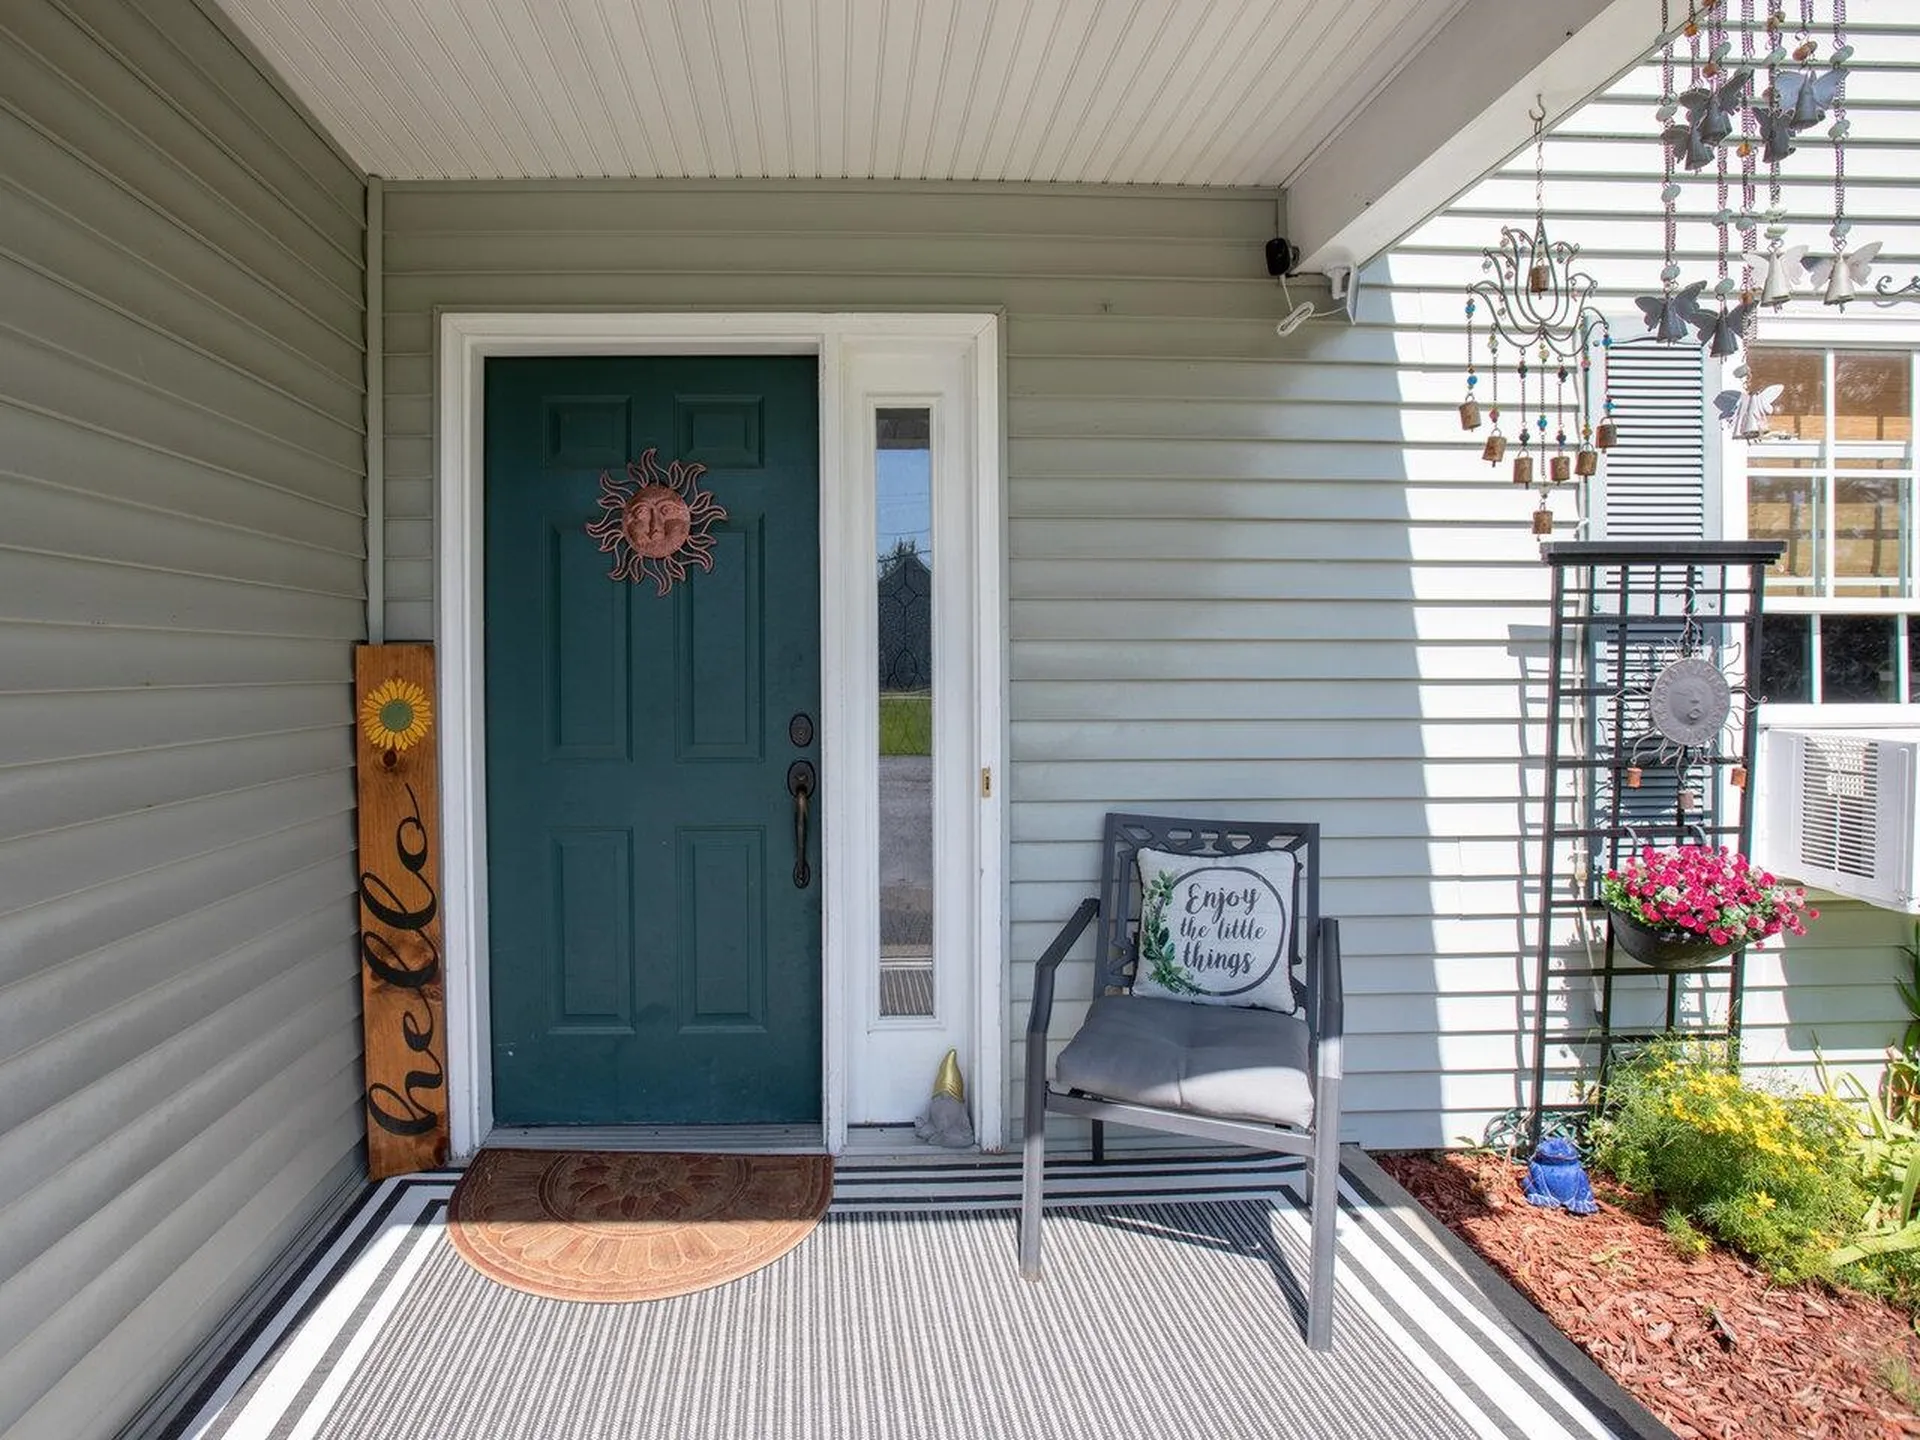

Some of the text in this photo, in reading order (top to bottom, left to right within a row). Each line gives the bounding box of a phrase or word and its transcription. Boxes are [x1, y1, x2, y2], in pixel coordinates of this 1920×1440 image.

[1185, 882, 1261, 924] Enjoy
[1180, 916, 1267, 941] the little
[360, 782, 443, 1137] hello
[1182, 941, 1255, 978] things
